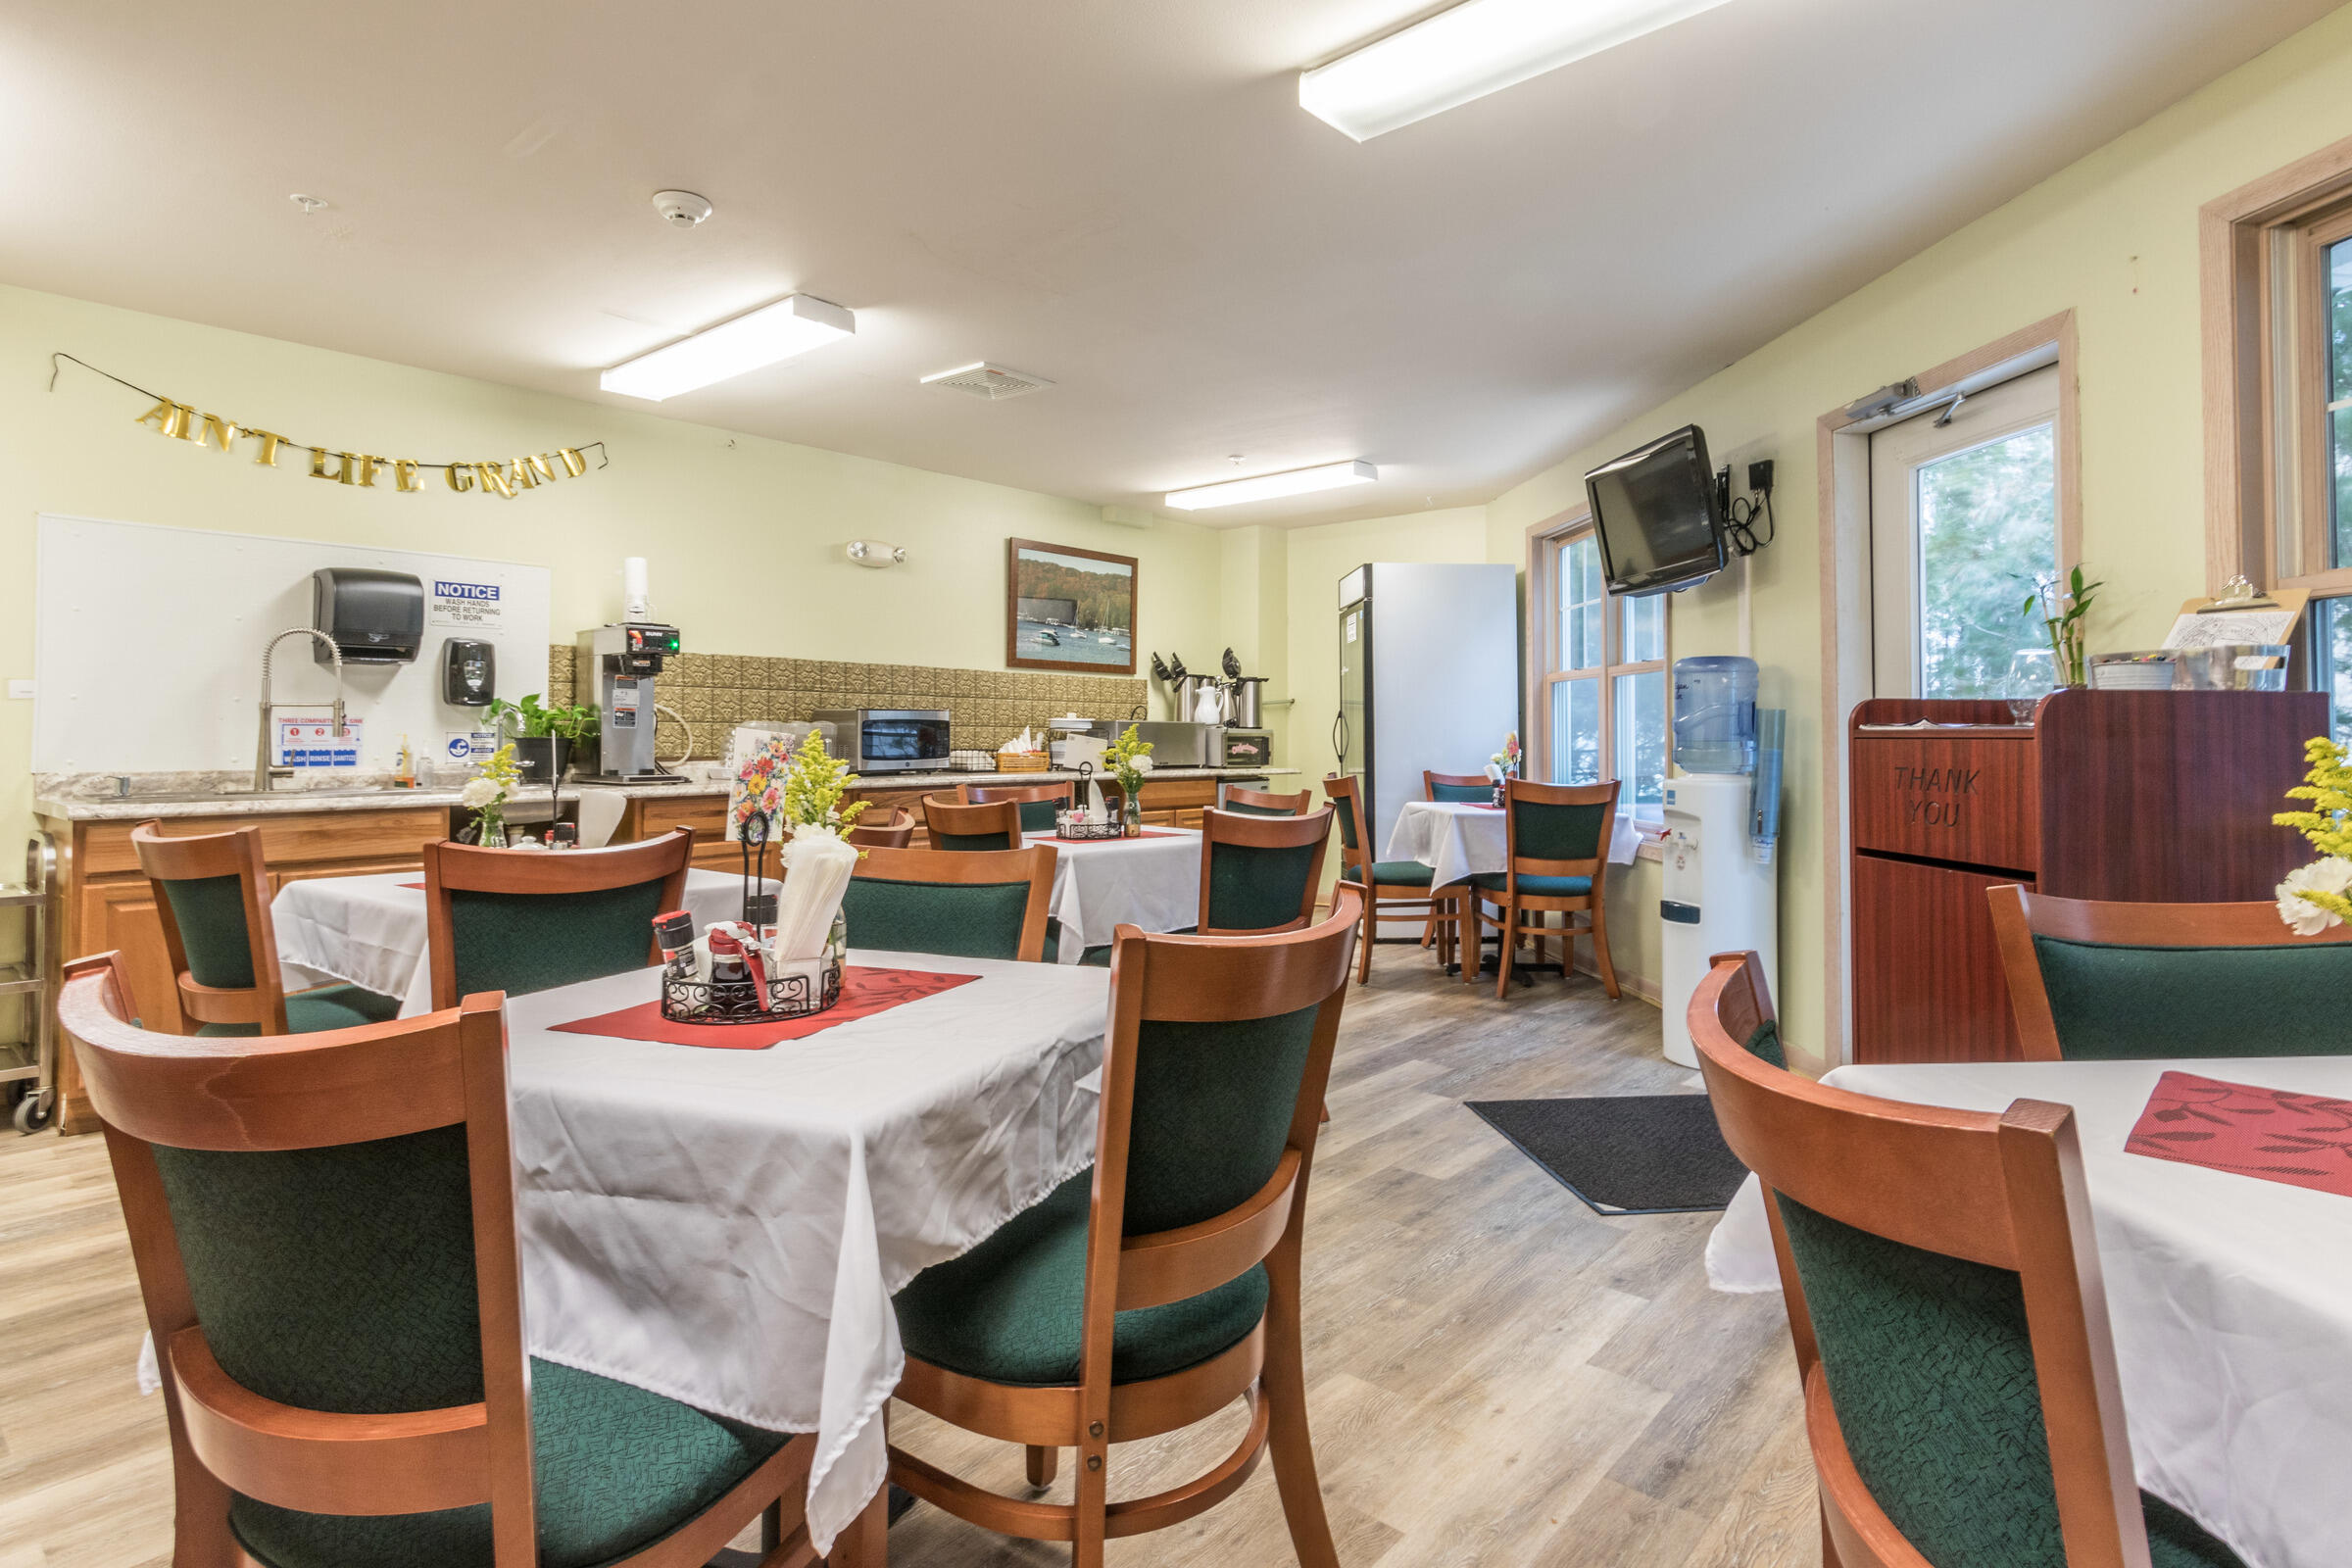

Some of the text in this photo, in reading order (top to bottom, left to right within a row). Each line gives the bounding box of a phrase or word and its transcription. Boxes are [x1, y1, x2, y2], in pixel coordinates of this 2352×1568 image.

[134, 395, 587, 499] AIN'T LIFE GRAND
[437, 582, 498, 600] NOTICE
[433, 604, 501, 616] BEFORE RETURNING
[1894, 766, 1981, 795] THANK
[1910, 800, 1961, 827] YOU
